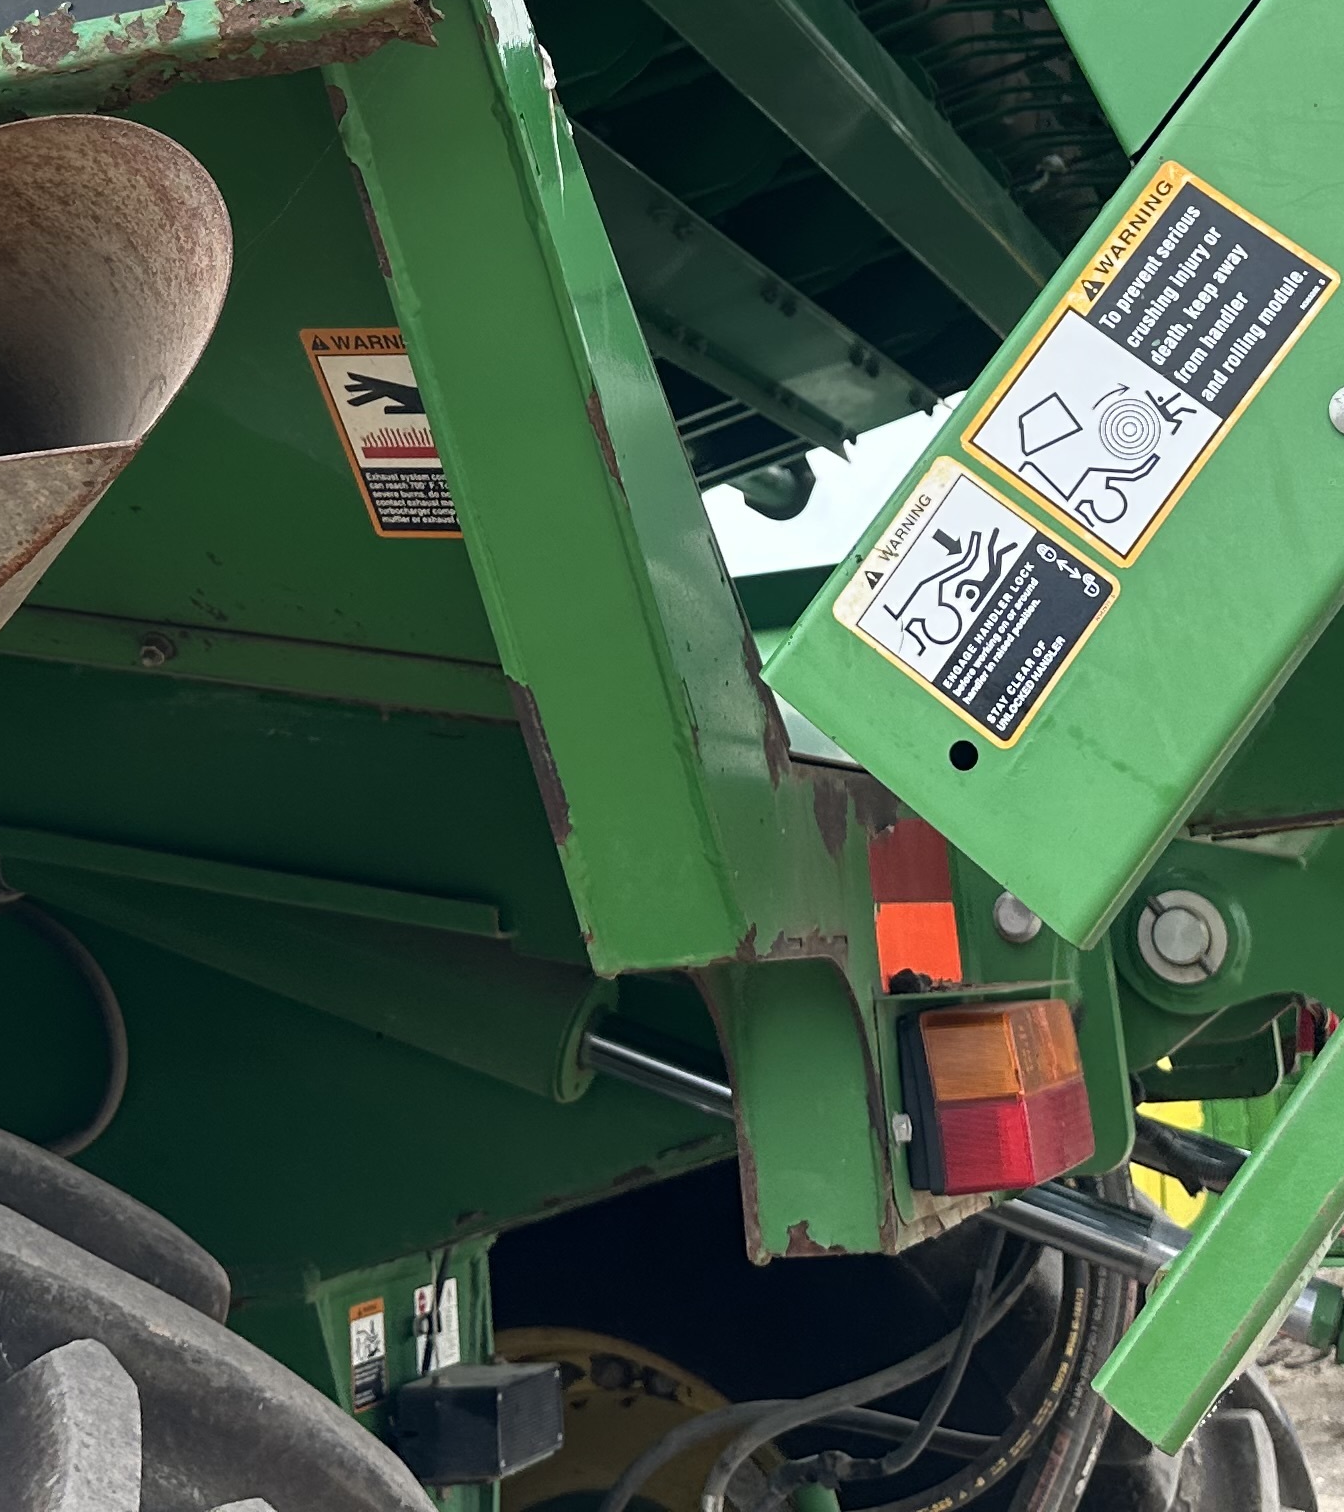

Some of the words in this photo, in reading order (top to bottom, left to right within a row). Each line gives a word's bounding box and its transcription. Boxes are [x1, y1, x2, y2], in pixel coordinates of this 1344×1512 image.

[1094, 180, 1172, 274] WARNING
[1098, 310, 1122, 329] To
[1115, 255, 1163, 314] prevent
[1156, 205, 1201, 259] serious
[1126, 285, 1180, 348] crushing
[1167, 243, 1211, 288] injury
[1203, 226, 1222, 246] or
[1150, 323, 1193, 366] death,
[1182, 282, 1219, 320] keep
[1212, 243, 1249, 284] away
[1173, 347, 1209, 384] from
[1198, 291, 1249, 350] handler
[1201, 369, 1229, 402] and
[1222, 323, 1267, 374] rolling
[1257, 270, 1309, 326] module.
[330, 334, 406, 350] WARNI
[879, 494, 932, 561] WARNING
[942, 643, 978, 690] ENGAGE
[973, 592, 1014, 645] HANDLER
[1009, 561, 1035, 593] LOCK
[952, 667, 977, 698] before
[972, 632, 1002, 669] working
[997, 620, 1010, 634] on
[1006, 608, 1017, 621] or
[1014, 576, 1039, 611] around
[961, 670, 989, 705] handler
[984, 661, 997, 673] in
[992, 632, 1016, 663] raised
[1011, 599, 1041, 638] position.
[986, 694, 1009, 724] STAY
[1006, 657, 1036, 696] CLEAR
[1032, 639, 1046, 658] OF
[995, 679, 1035, 732] UNLOCKED
[1030, 635, 1066, 682] HANDLER
